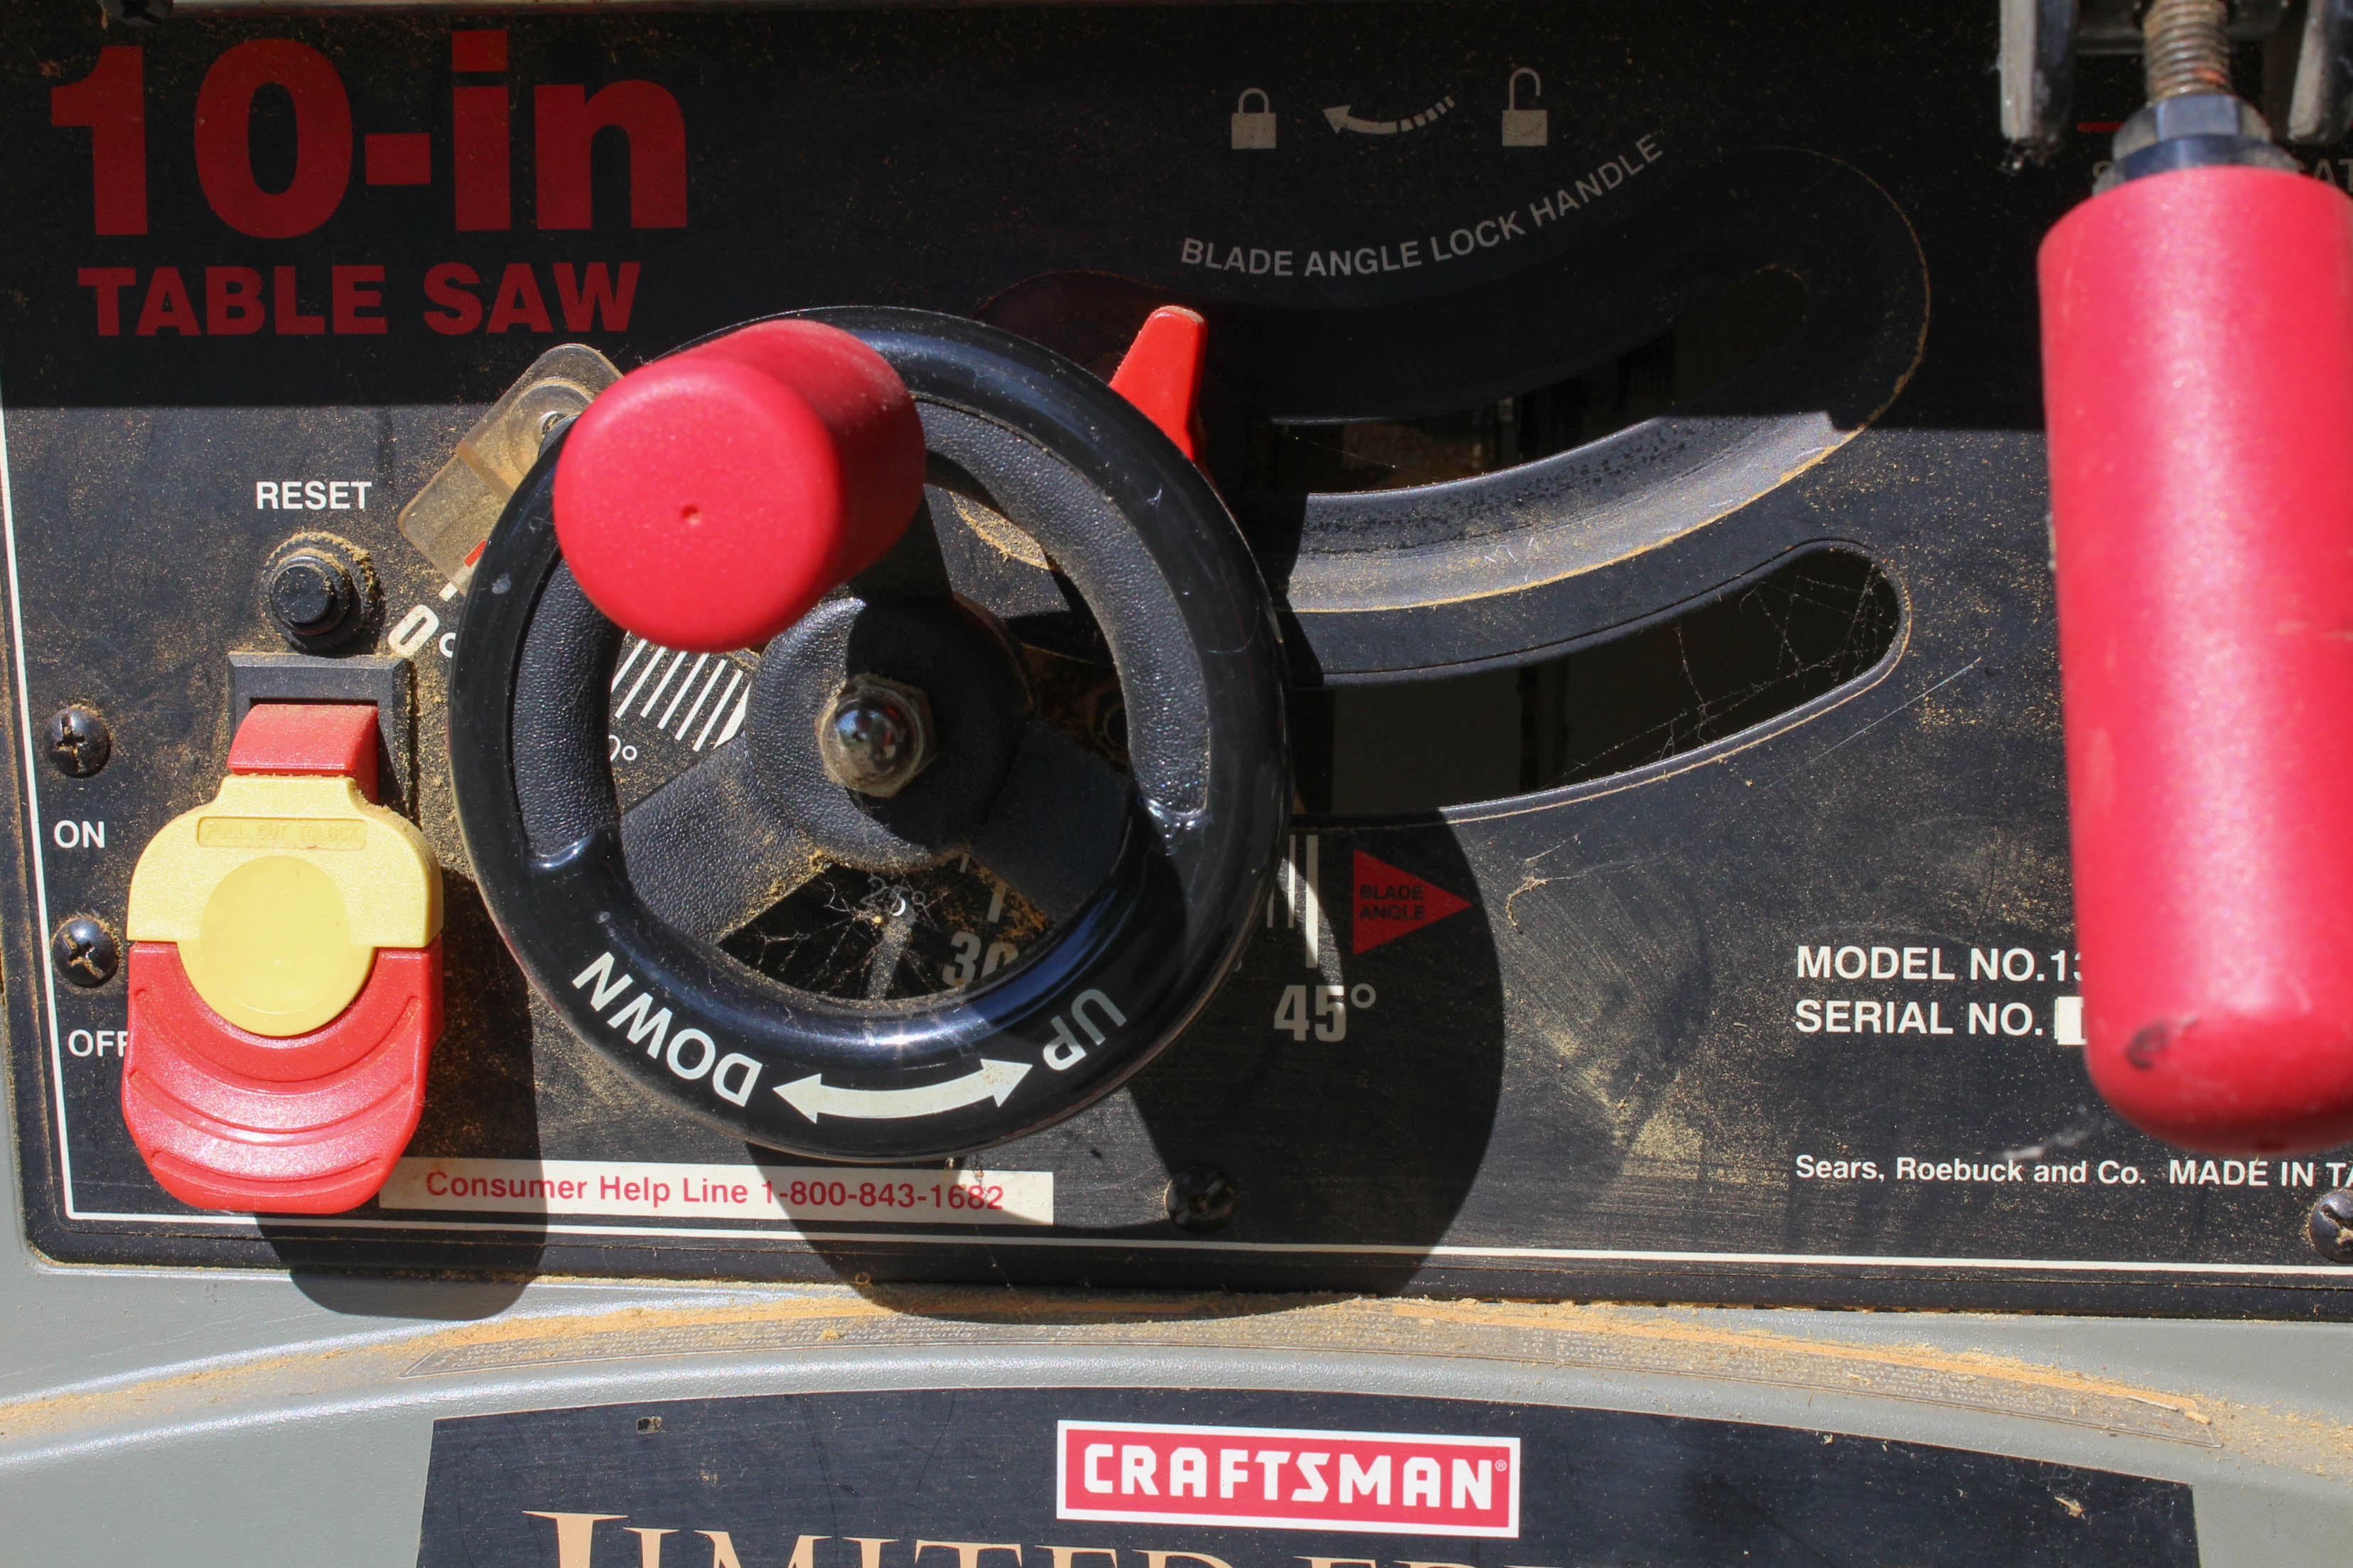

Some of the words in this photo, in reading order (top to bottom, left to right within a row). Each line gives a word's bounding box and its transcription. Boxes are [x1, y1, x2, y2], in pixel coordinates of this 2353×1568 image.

[51, 29, 687, 239] 10-in
[1181, 238, 1293, 276] BLADE
[1304, 241, 1421, 276] ANGLE
[1430, 210, 1526, 262] LOCK
[1529, 134, 1664, 227] HANDLE
[77, 265, 387, 336] TABLE
[424, 262, 640, 335] SAW
[257, 481, 372, 509] RESET
[54, 820, 104, 848] ON
[1360, 885, 1423, 901] BLADE
[1359, 904, 1425, 921] ANGLE
[1797, 946, 1955, 980] MODEL
[572, 951, 763, 1107] DOWN
[1043, 989, 1127, 1070] UP
[1796, 1000, 1953, 1034] SERIAL
[1968, 1002, 2043, 1036] NO.
[68, 1029, 128, 1057] OFF
[1796, 1155, 1884, 1182] Sears,
[1897, 1157, 2023, 1182] Roebuck
[2033, 1159, 2087, 1184] and
[2098, 1160, 2146, 1184] Co.
[2170, 1159, 2269, 1186] MADE
[2281, 1162, 2314, 1186] IN
[426, 1172, 587, 1199] Consumer
[600, 1176, 670, 1207] Help
[684, 1178, 748, 1204] Line
[762, 1181, 1003, 1210] 1-800-843-1682
